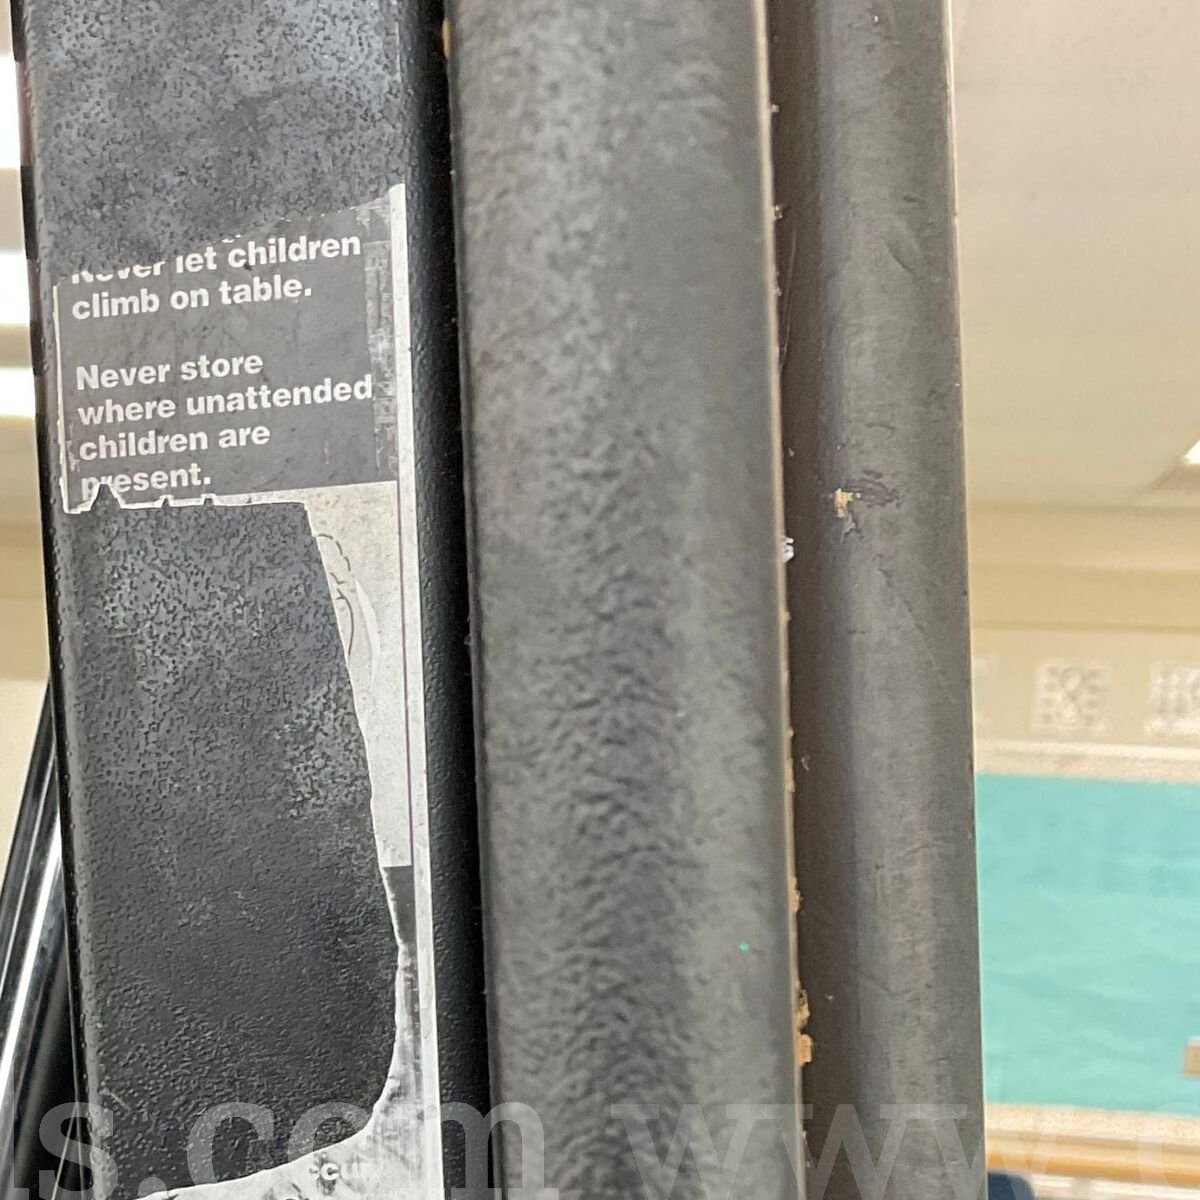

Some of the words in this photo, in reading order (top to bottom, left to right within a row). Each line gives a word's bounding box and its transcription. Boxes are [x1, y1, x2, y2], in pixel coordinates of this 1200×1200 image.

[176, 246, 217, 274] let
[227, 235, 361, 268] children
[72, 288, 160, 320] climb
[170, 288, 209, 310] on
[219, 274, 312, 305] table.
[77, 360, 170, 390] Never
[181, 354, 263, 381] store
[78, 395, 176, 425] where
[186, 374, 373, 416] unattended
[79, 430, 208, 461] children
[218, 427, 270, 448] are
